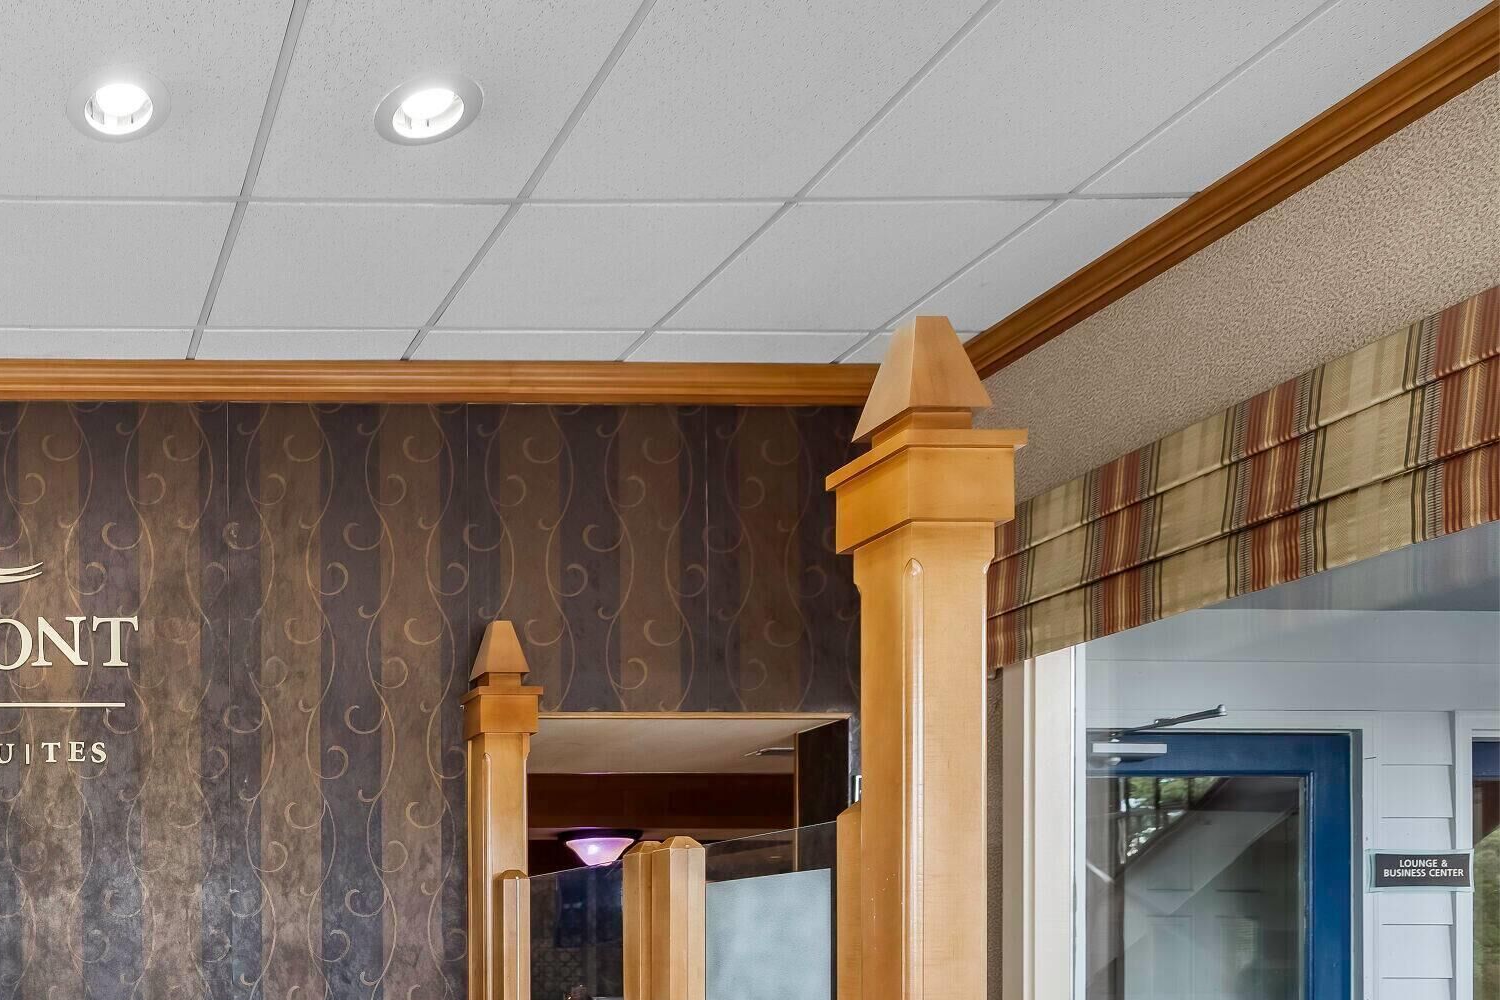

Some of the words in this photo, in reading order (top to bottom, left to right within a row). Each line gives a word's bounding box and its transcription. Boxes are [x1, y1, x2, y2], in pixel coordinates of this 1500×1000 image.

[1399, 859, 1438, 868] LOUNGE
[1441, 859, 1448, 868] &
[1383, 868, 1427, 877] BUSINESS
[1428, 868, 1464, 877] CENTER
